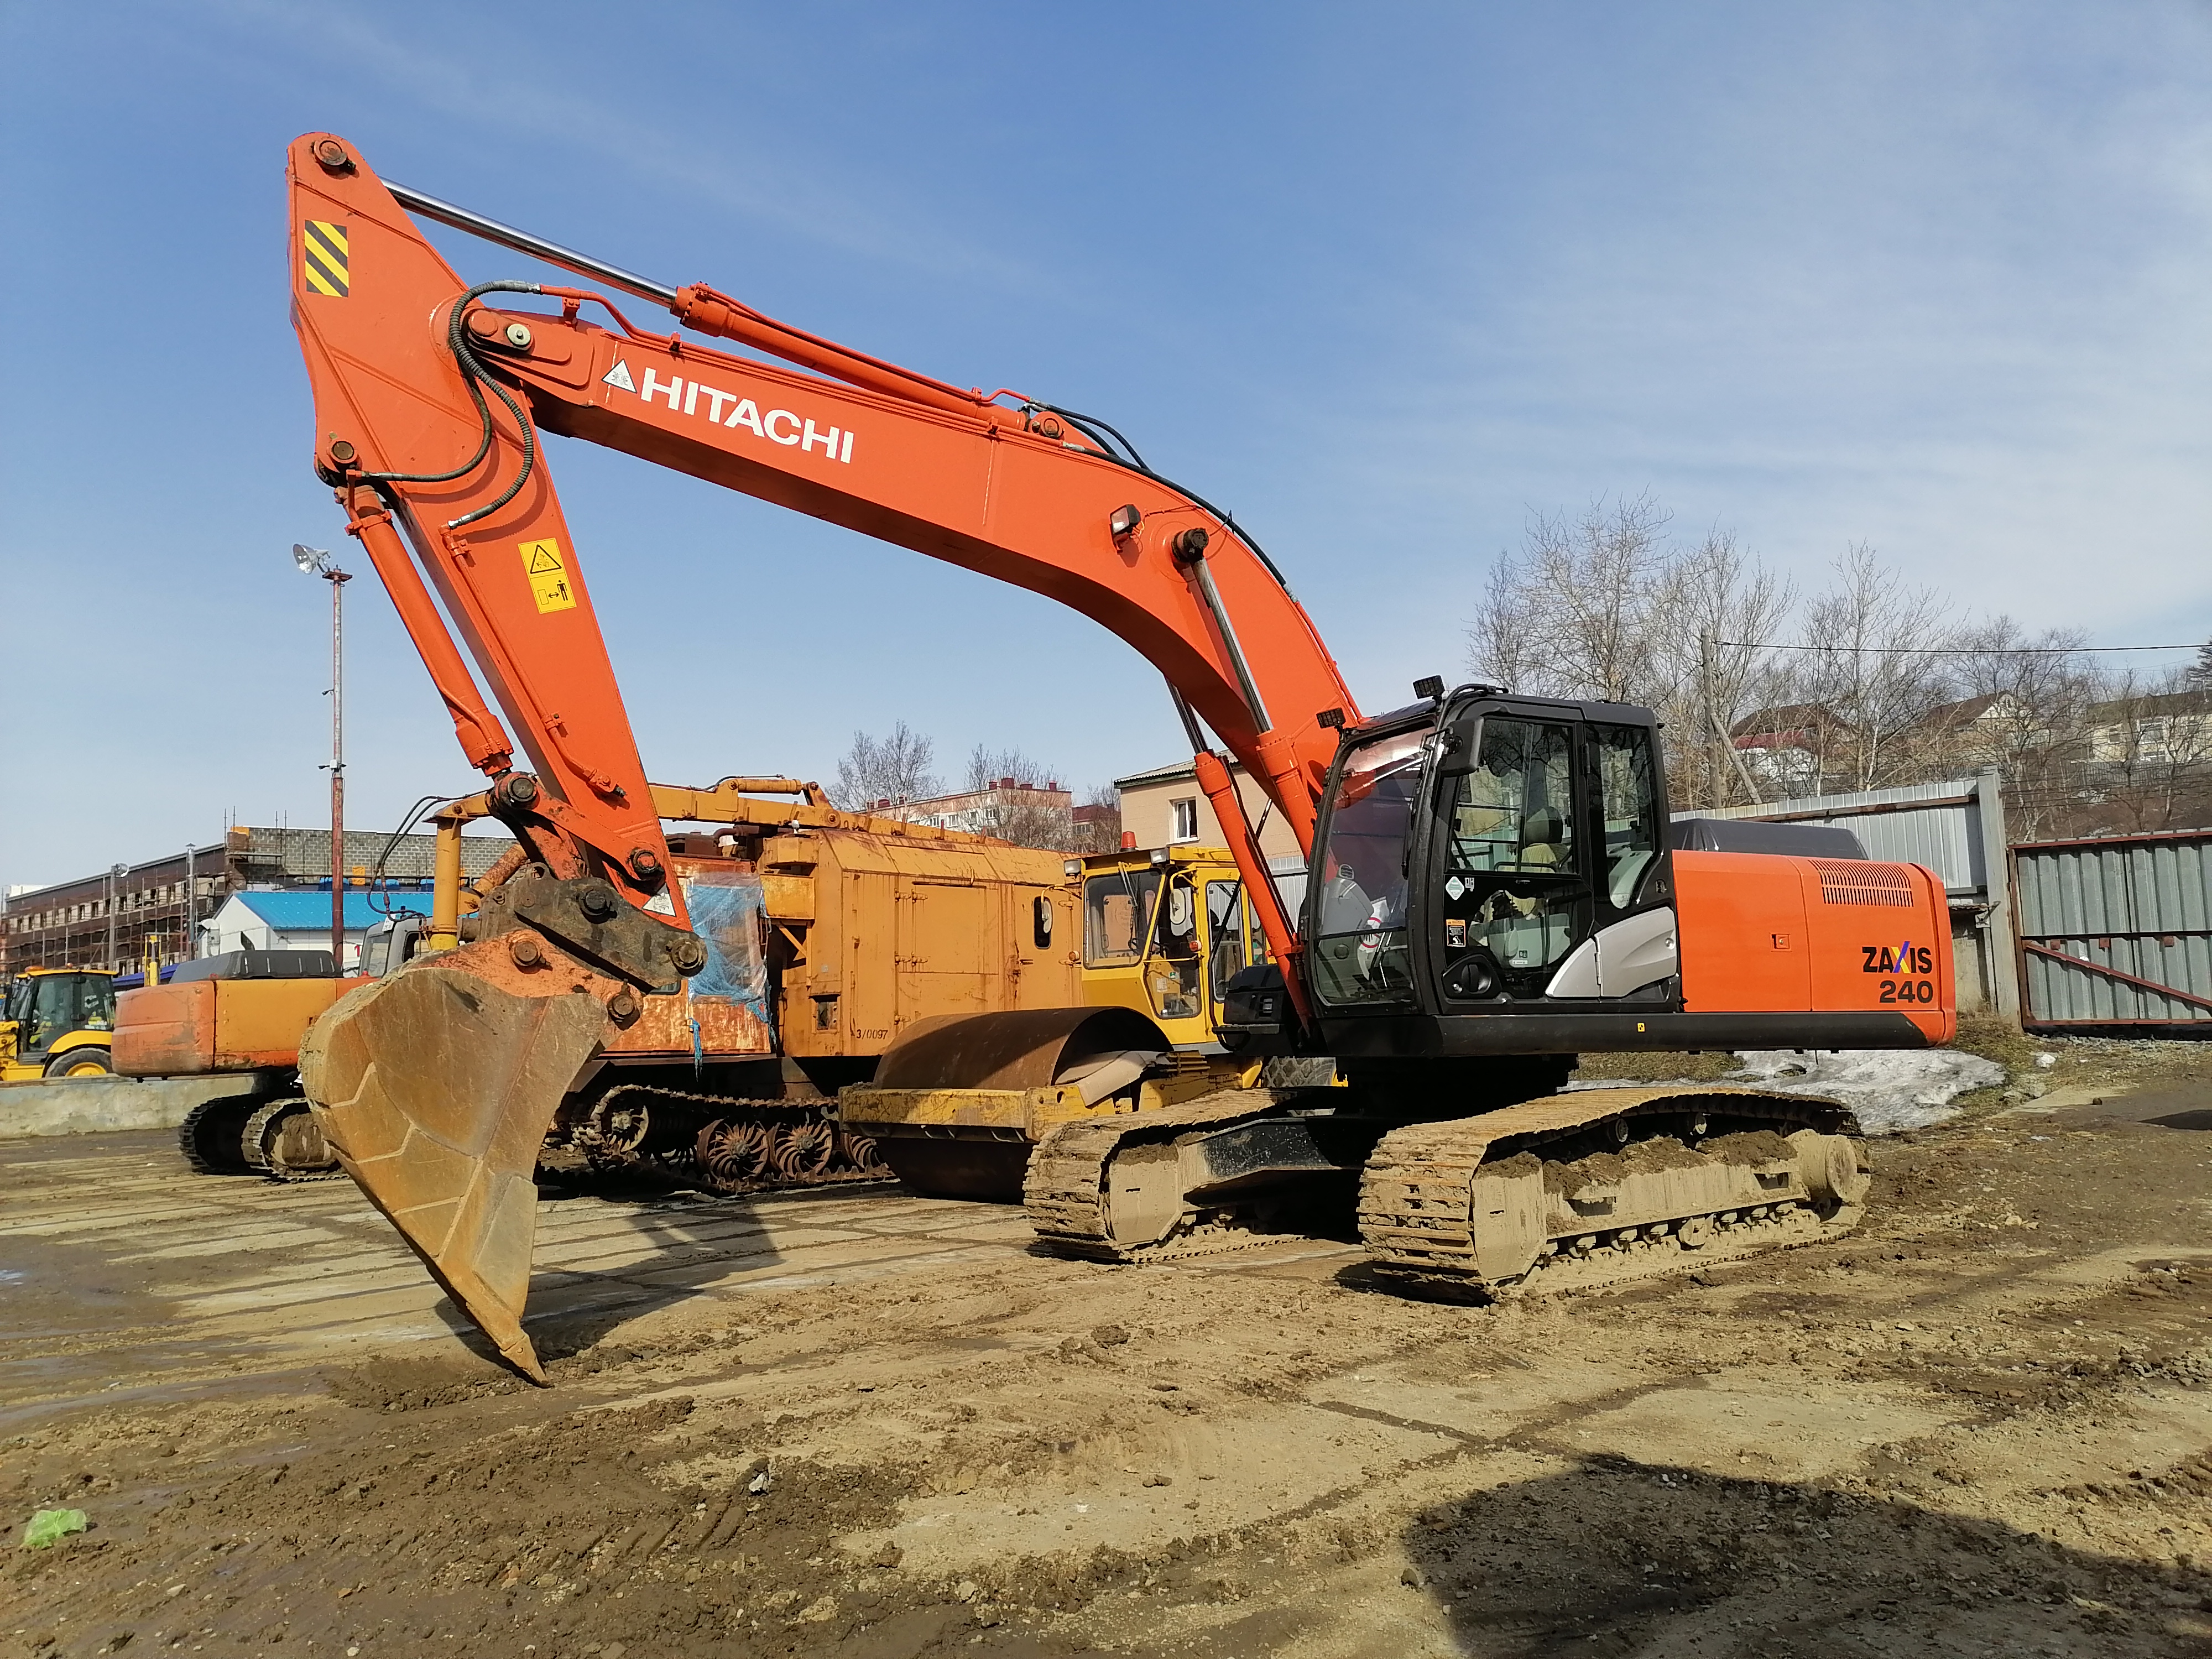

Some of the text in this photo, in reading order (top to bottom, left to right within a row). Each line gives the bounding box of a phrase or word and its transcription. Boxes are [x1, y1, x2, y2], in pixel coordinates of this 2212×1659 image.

[640, 367, 854, 463] HITACHI
[1862, 941, 1932, 973] ZAXIS
[1879, 980, 1933, 1003] 240
